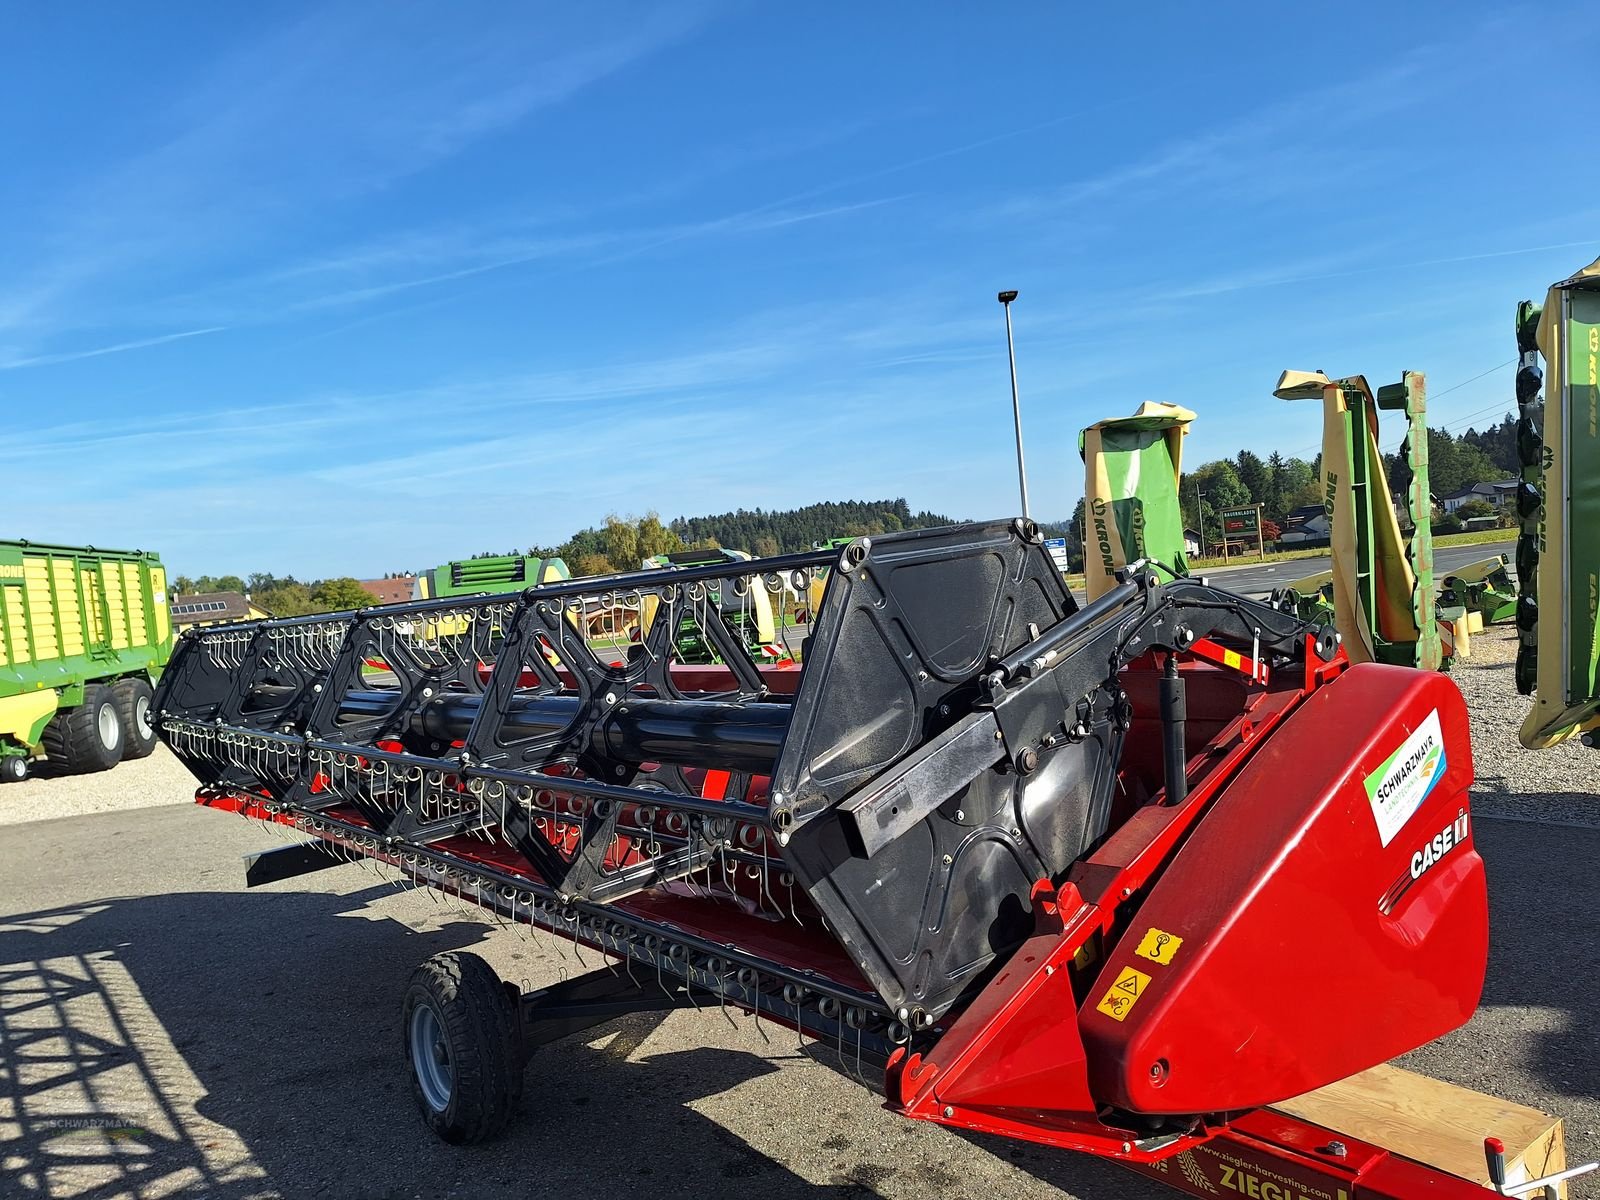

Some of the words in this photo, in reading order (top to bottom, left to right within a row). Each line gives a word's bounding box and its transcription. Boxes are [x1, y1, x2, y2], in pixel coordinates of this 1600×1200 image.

[1589, 353, 1597, 438] KRONE
[1094, 518, 1115, 576] KRONE
[1377, 734, 1434, 804] SCHWARZMAYR
[1410, 824, 1453, 880] CASE
[1195, 1144, 1332, 1200] www.ziegler-harvesting.com
